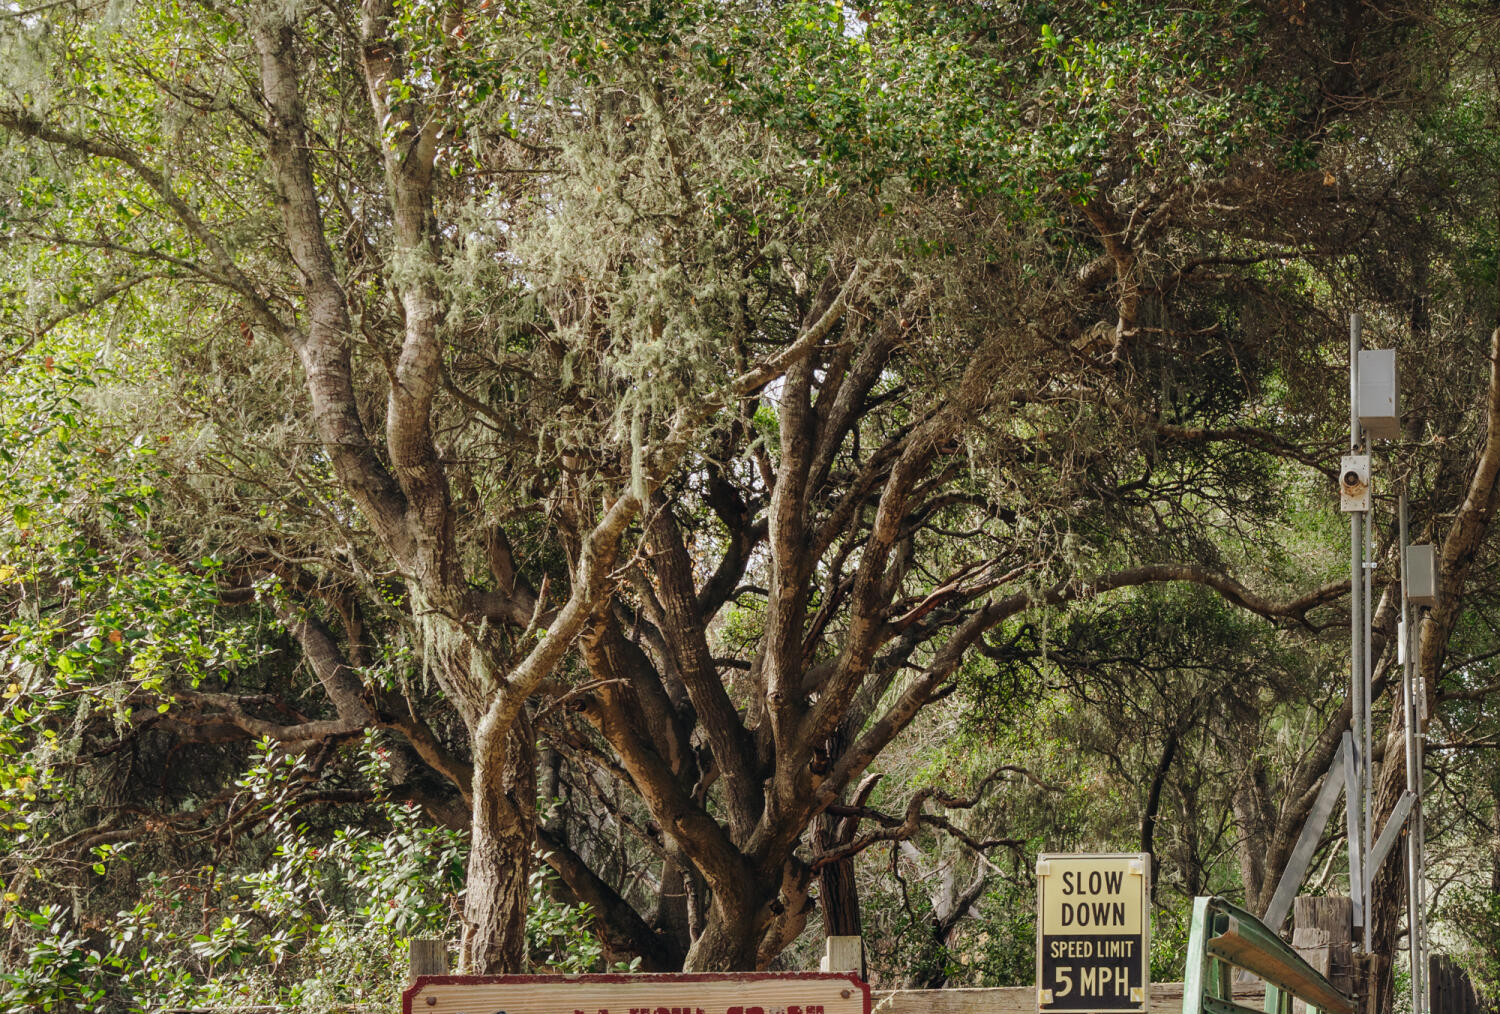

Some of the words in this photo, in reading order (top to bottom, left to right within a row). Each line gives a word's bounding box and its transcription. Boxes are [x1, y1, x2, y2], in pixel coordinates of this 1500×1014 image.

[1062, 871, 1124, 896] SLOW
[1061, 902, 1126, 927] DOWN
[1050, 940, 1093, 958] SPEED
[1097, 940, 1134, 958] LIMIT
[1055, 966, 1073, 997] 5
[1080, 966, 1129, 997] MPH
